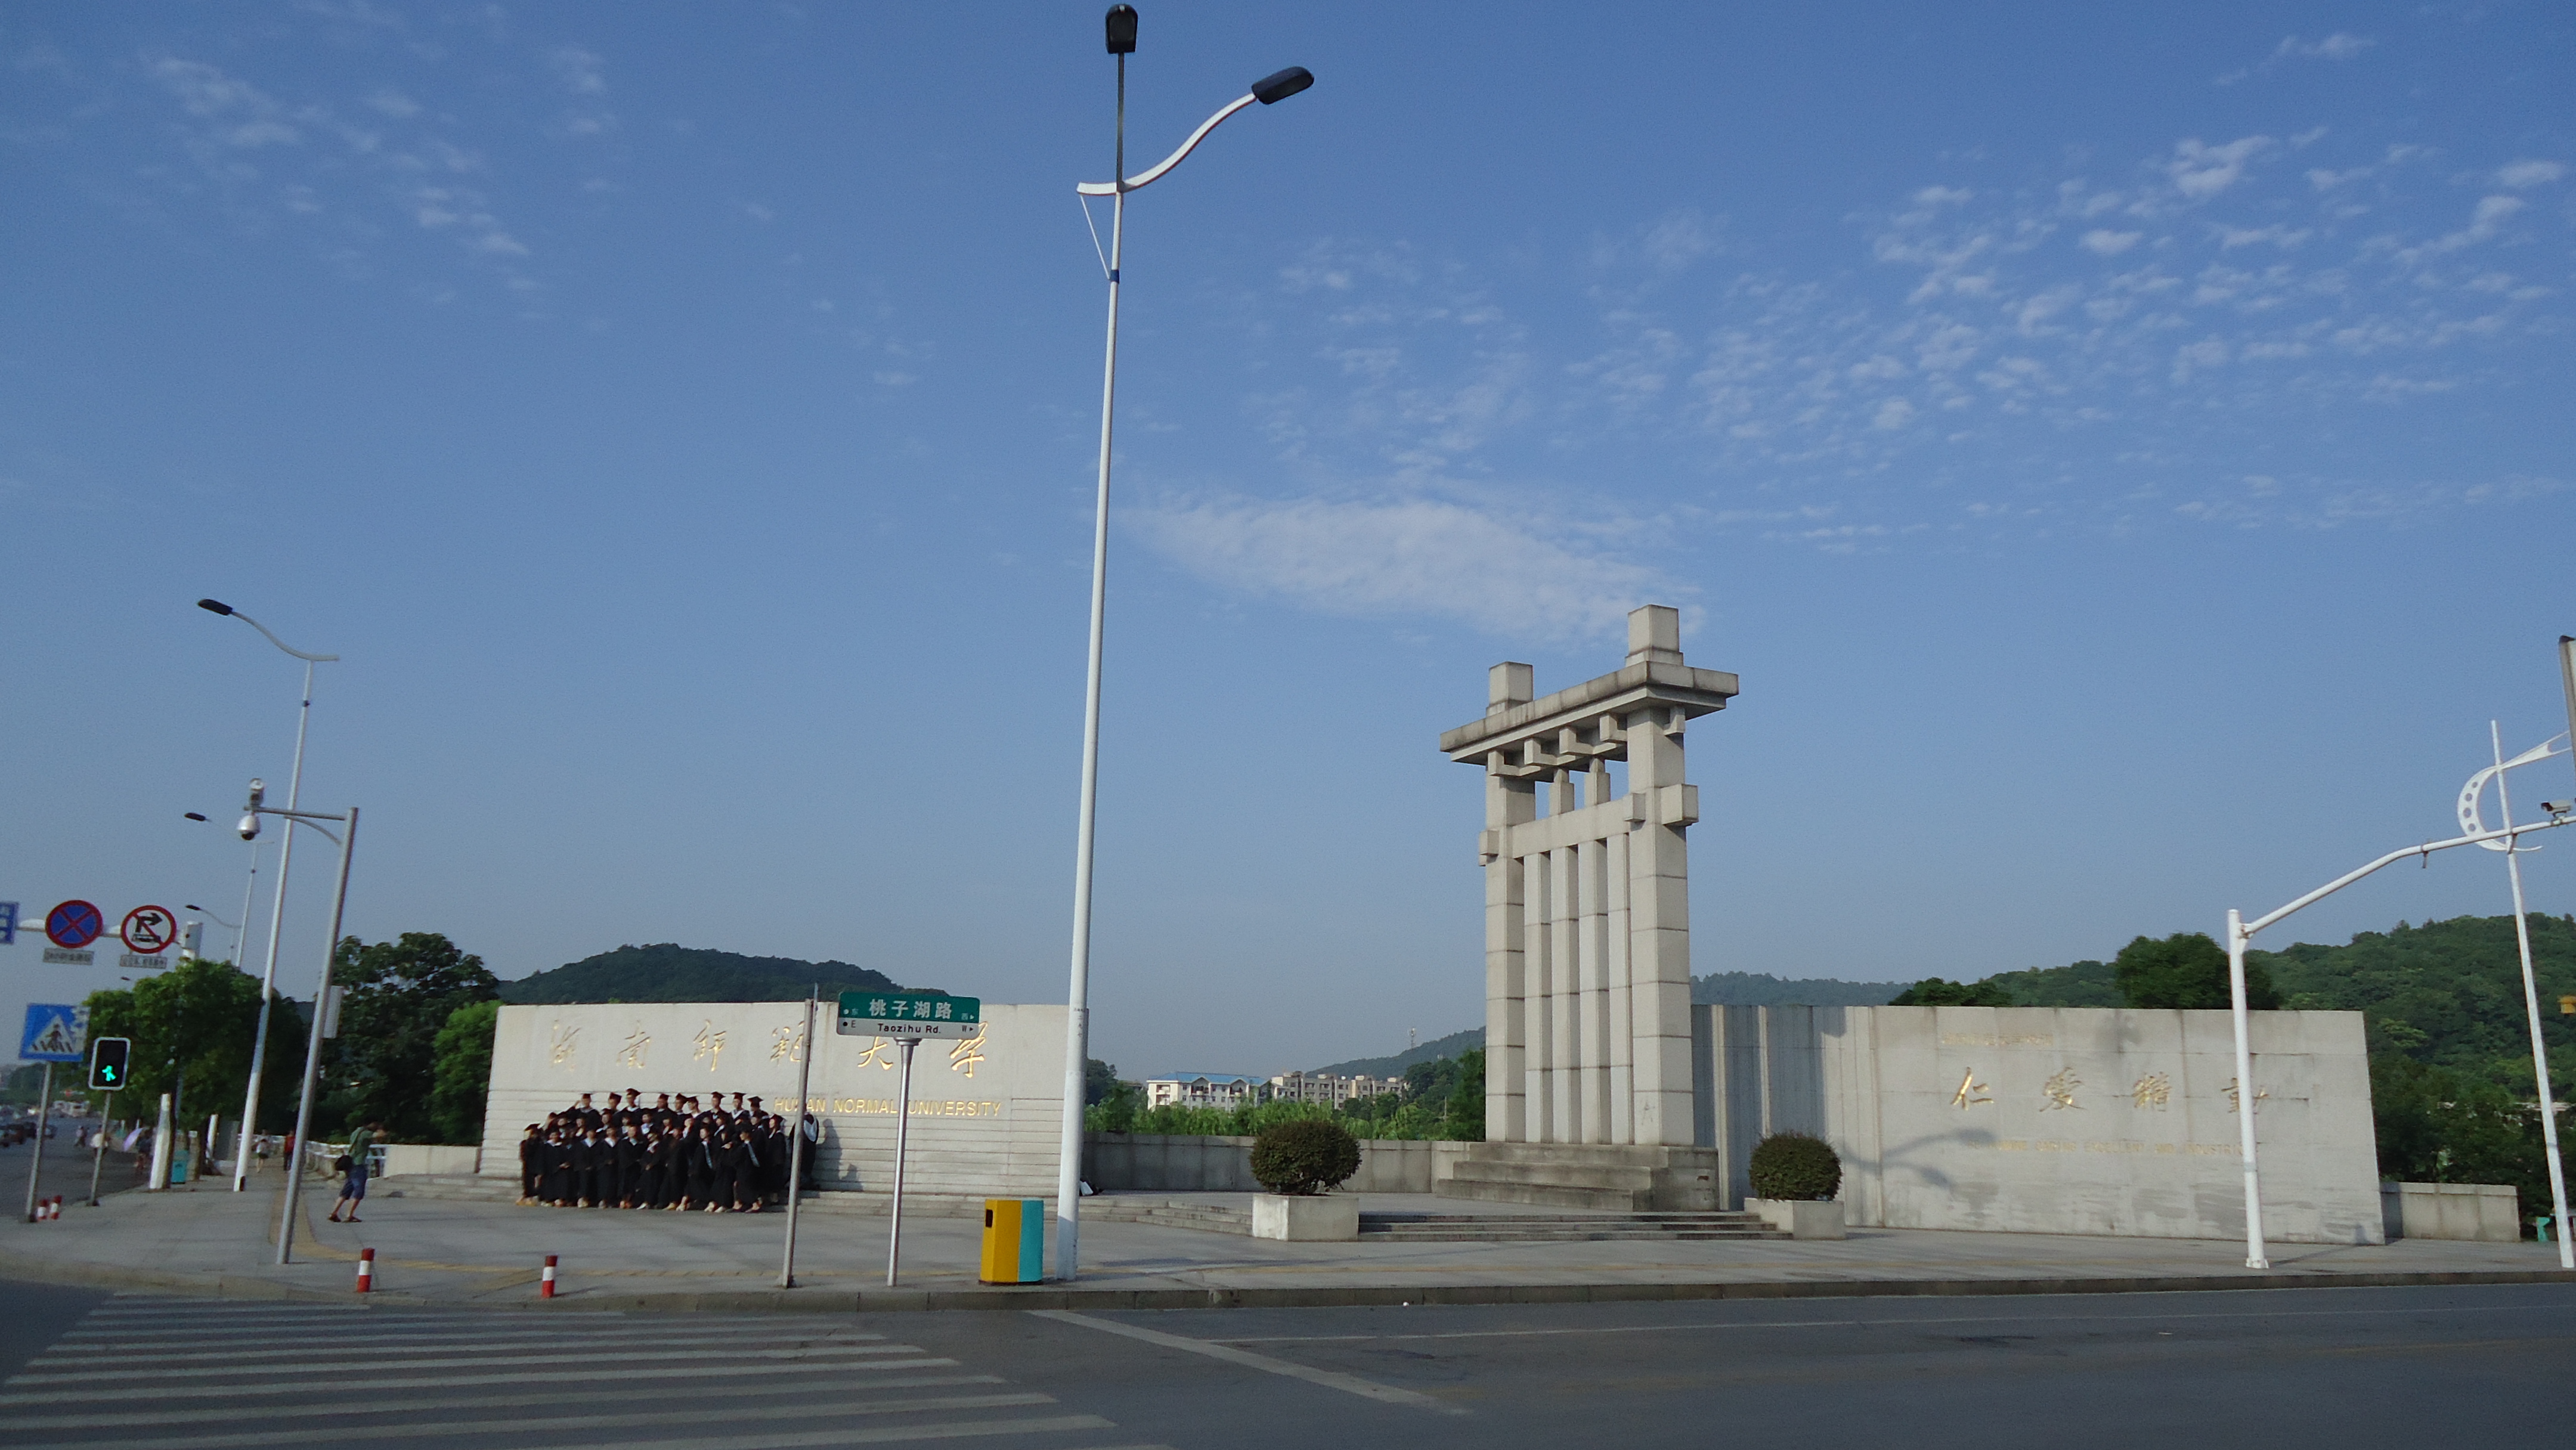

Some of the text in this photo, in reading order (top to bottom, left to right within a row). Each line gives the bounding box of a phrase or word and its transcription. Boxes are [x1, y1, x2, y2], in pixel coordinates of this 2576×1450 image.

[869, 999, 952, 1020] 桃子湖路
[850, 1020, 857, 1028] E
[878, 1023, 941, 1034] Taozihu Rd.
[833, 1098, 897, 1114] NORMAL
[908, 1100, 1002, 1117] UNIVERSITY
